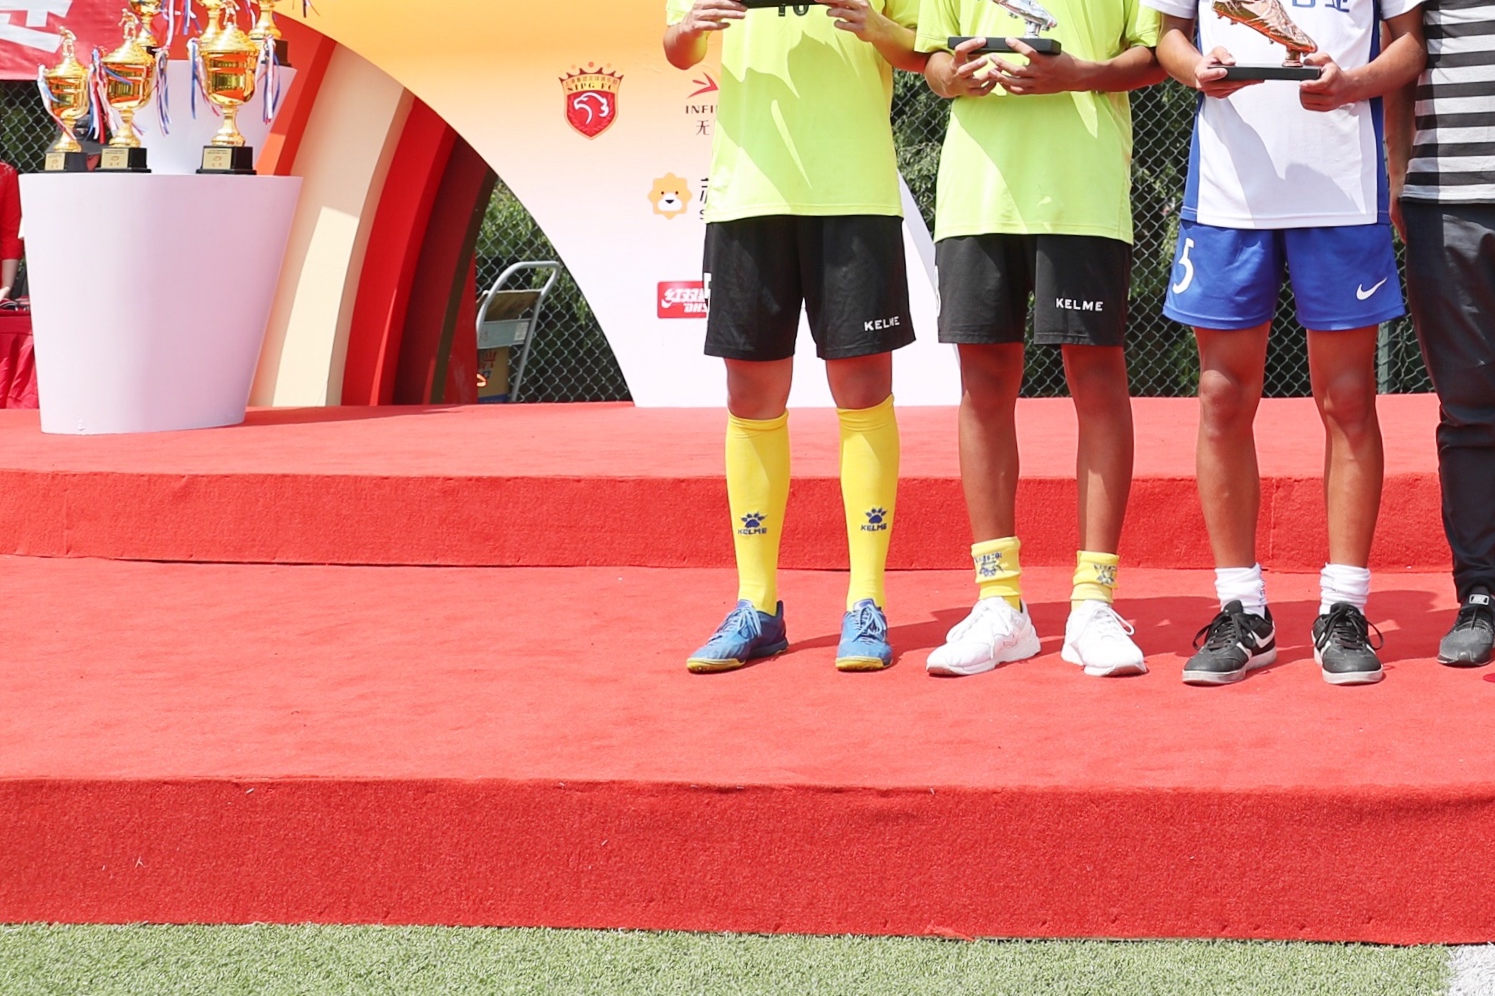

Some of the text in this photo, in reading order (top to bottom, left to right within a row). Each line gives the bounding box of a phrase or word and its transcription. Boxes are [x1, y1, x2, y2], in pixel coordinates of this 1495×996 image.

[1055, 298, 1103, 312] KELME
[864, 316, 900, 331] KELME
[737, 527, 768, 535] KELME
[860, 523, 887, 532] KELME
